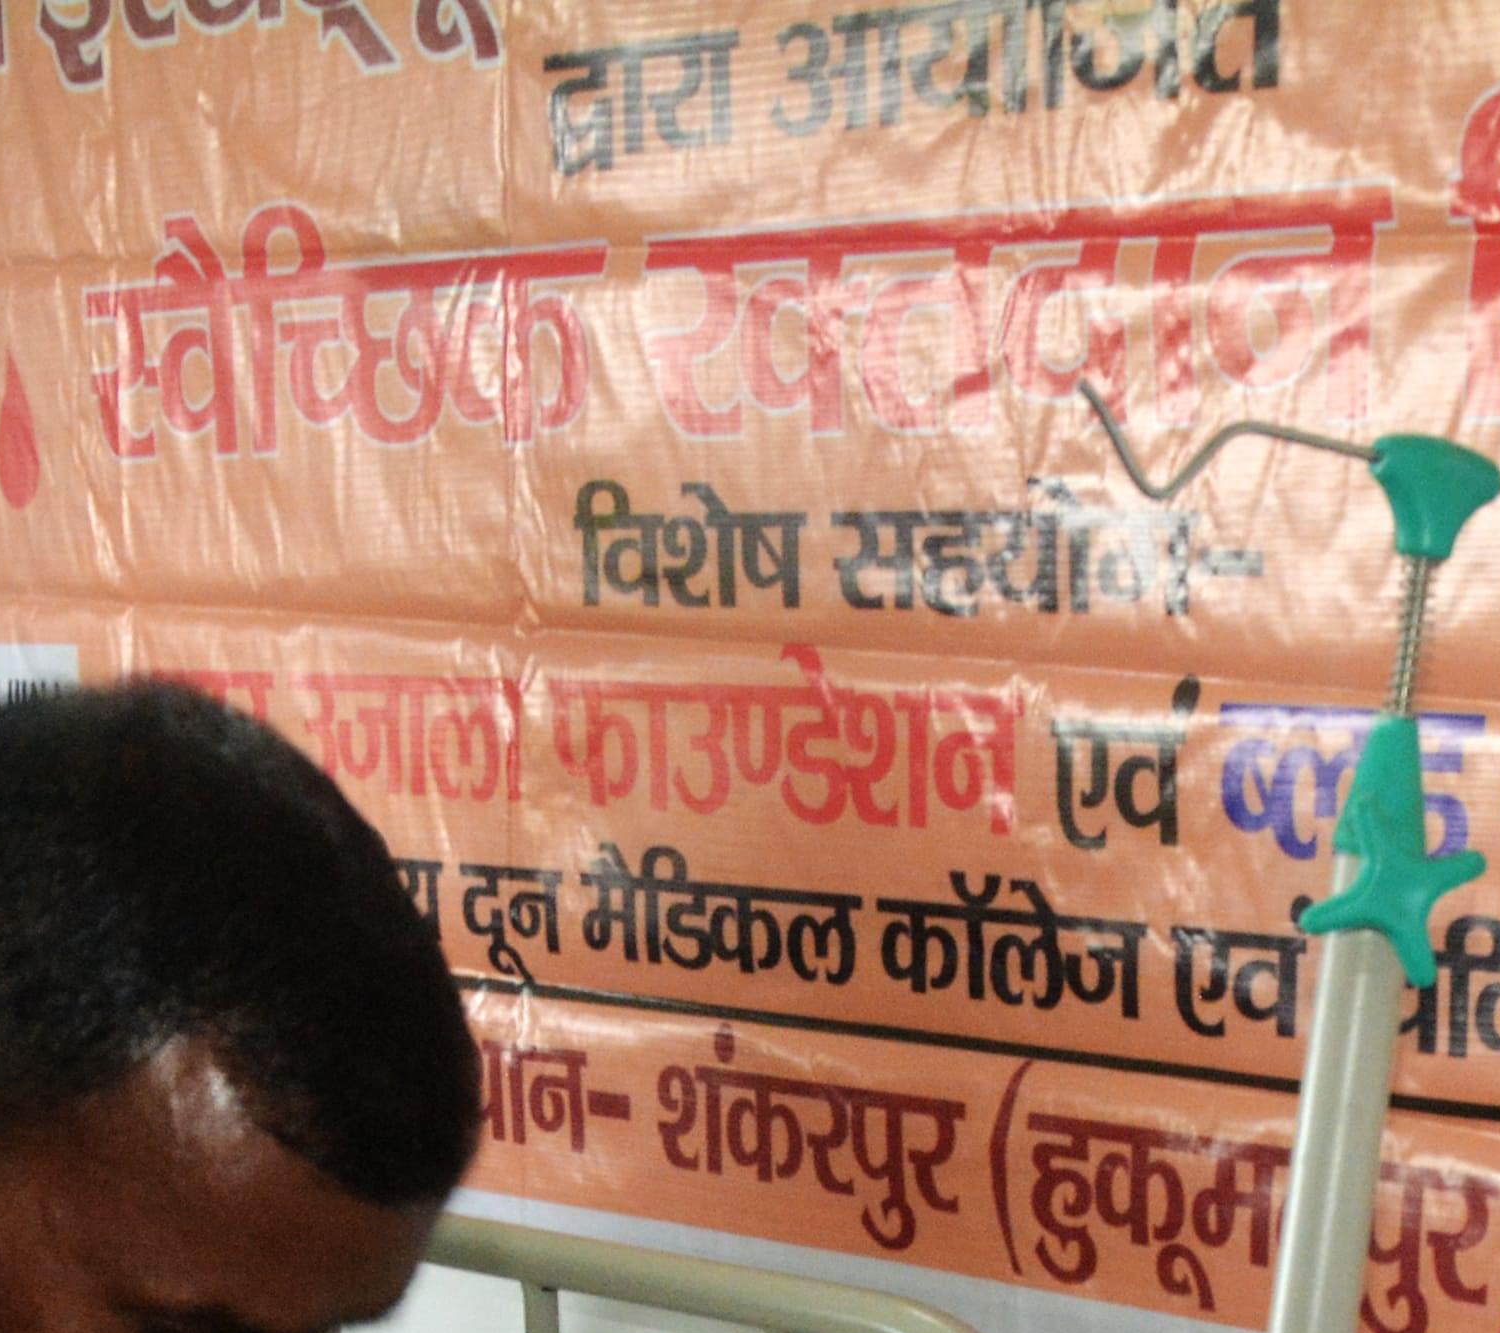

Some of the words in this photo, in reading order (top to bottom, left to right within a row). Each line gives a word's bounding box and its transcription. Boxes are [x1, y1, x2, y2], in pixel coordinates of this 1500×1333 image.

[542, 30, 740, 177] द्वारा
[82, 199, 608, 460] स्वैच्छिक
[643, 178, 1396, 441] रक्तदान
[573, 479, 808, 609] विशेष
[288, 673, 522, 801] उजाला
[548, 643, 1024, 836] फाउण्डेशन
[1051, 674, 1200, 850] एवं
[459, 863, 562, 985] दून
[876, 870, 1147, 1018] कॉलेज
[656, 1022, 964, 1250] शंकरपुर
